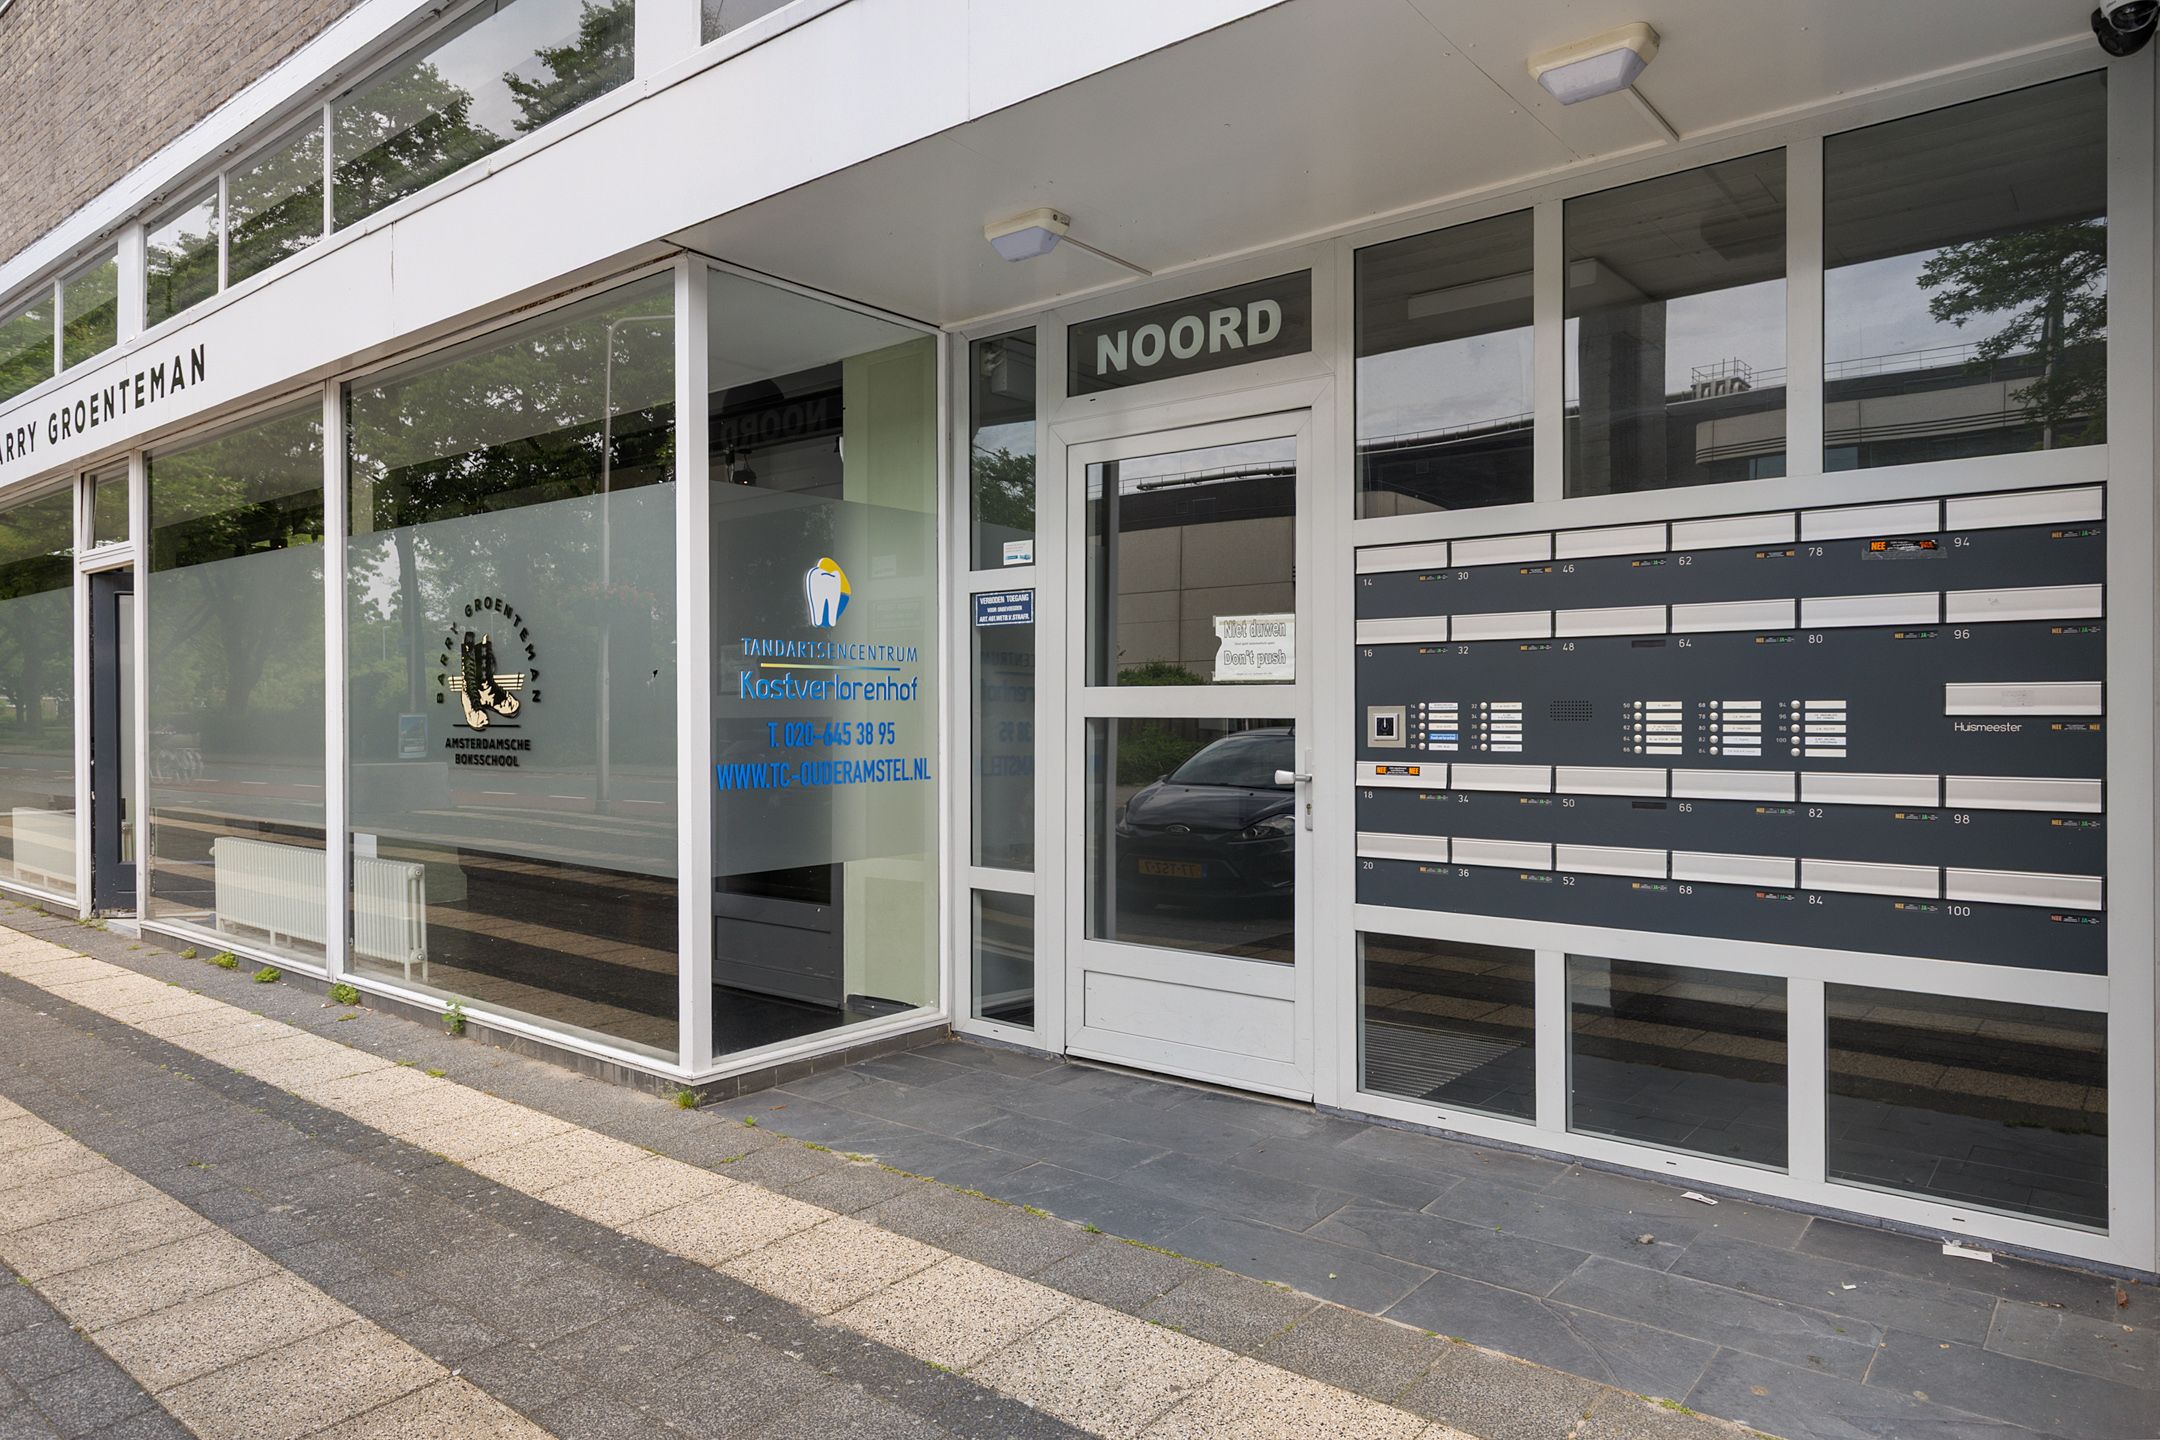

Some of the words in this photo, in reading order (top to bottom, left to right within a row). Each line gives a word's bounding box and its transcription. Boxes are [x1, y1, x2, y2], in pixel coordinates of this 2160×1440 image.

[1097, 299, 1282, 375] NOORD
[48, 343, 205, 445] GROENTEMAN
[1871, 542, 1886, 550] NEE
[1954, 536, 1970, 548] 94
[1808, 546, 1822, 556] 78
[1678, 556, 1692, 566] 62
[1562, 564, 1574, 572] 46
[1458, 572, 1468, 580] 30
[1364, 578, 1372, 586] 14
[979, 596, 1004, 605] VERBODEN
[1006, 594, 1029, 602] TOEGANG
[1224, 620, 1247, 638] Niet
[1249, 619, 1286, 637] duwen
[1808, 634, 1822, 644] 80
[1954, 630, 1970, 640] 96
[1562, 642, 1574, 652] 48
[1678, 638, 1692, 648] 64
[437, 622, 459, 703] BARRY
[464, 596, 542, 703] GROENTEMAN
[741, 638, 918, 662] TANDARTSENCENTRUM
[1458, 646, 1468, 654] 32
[1224, 649, 1254, 665] Don't
[1257, 649, 1286, 668] push
[740, 670, 918, 701] Kostverlorenhof
[1954, 722, 2022, 732] Huismeester
[768, 722, 779, 748] T.
[784, 722, 851, 748] 020-645
[856, 722, 873, 745] 38
[878, 722, 895, 745] 95
[445, 738, 531, 750] AMSTERDAMSCHE
[455, 753, 520, 767] BOKSSCHOOL
[716, 758, 931, 791] WWW.TC-OUDERAMSTEL.NL
[1364, 790, 1374, 798] 18
[1458, 794, 1468, 802] 34
[1562, 798, 1574, 808] 50
[1678, 802, 1692, 812] 66
[1808, 808, 1822, 818] 82
[1954, 814, 1970, 824] 98
[1364, 862, 1374, 870] 20
[1458, 868, 1470, 878] 36
[1562, 876, 1574, 886] 52
[1680, 886, 1692, 894] 68
[1808, 894, 1822, 904] 84
[1948, 906, 1970, 916] 100
